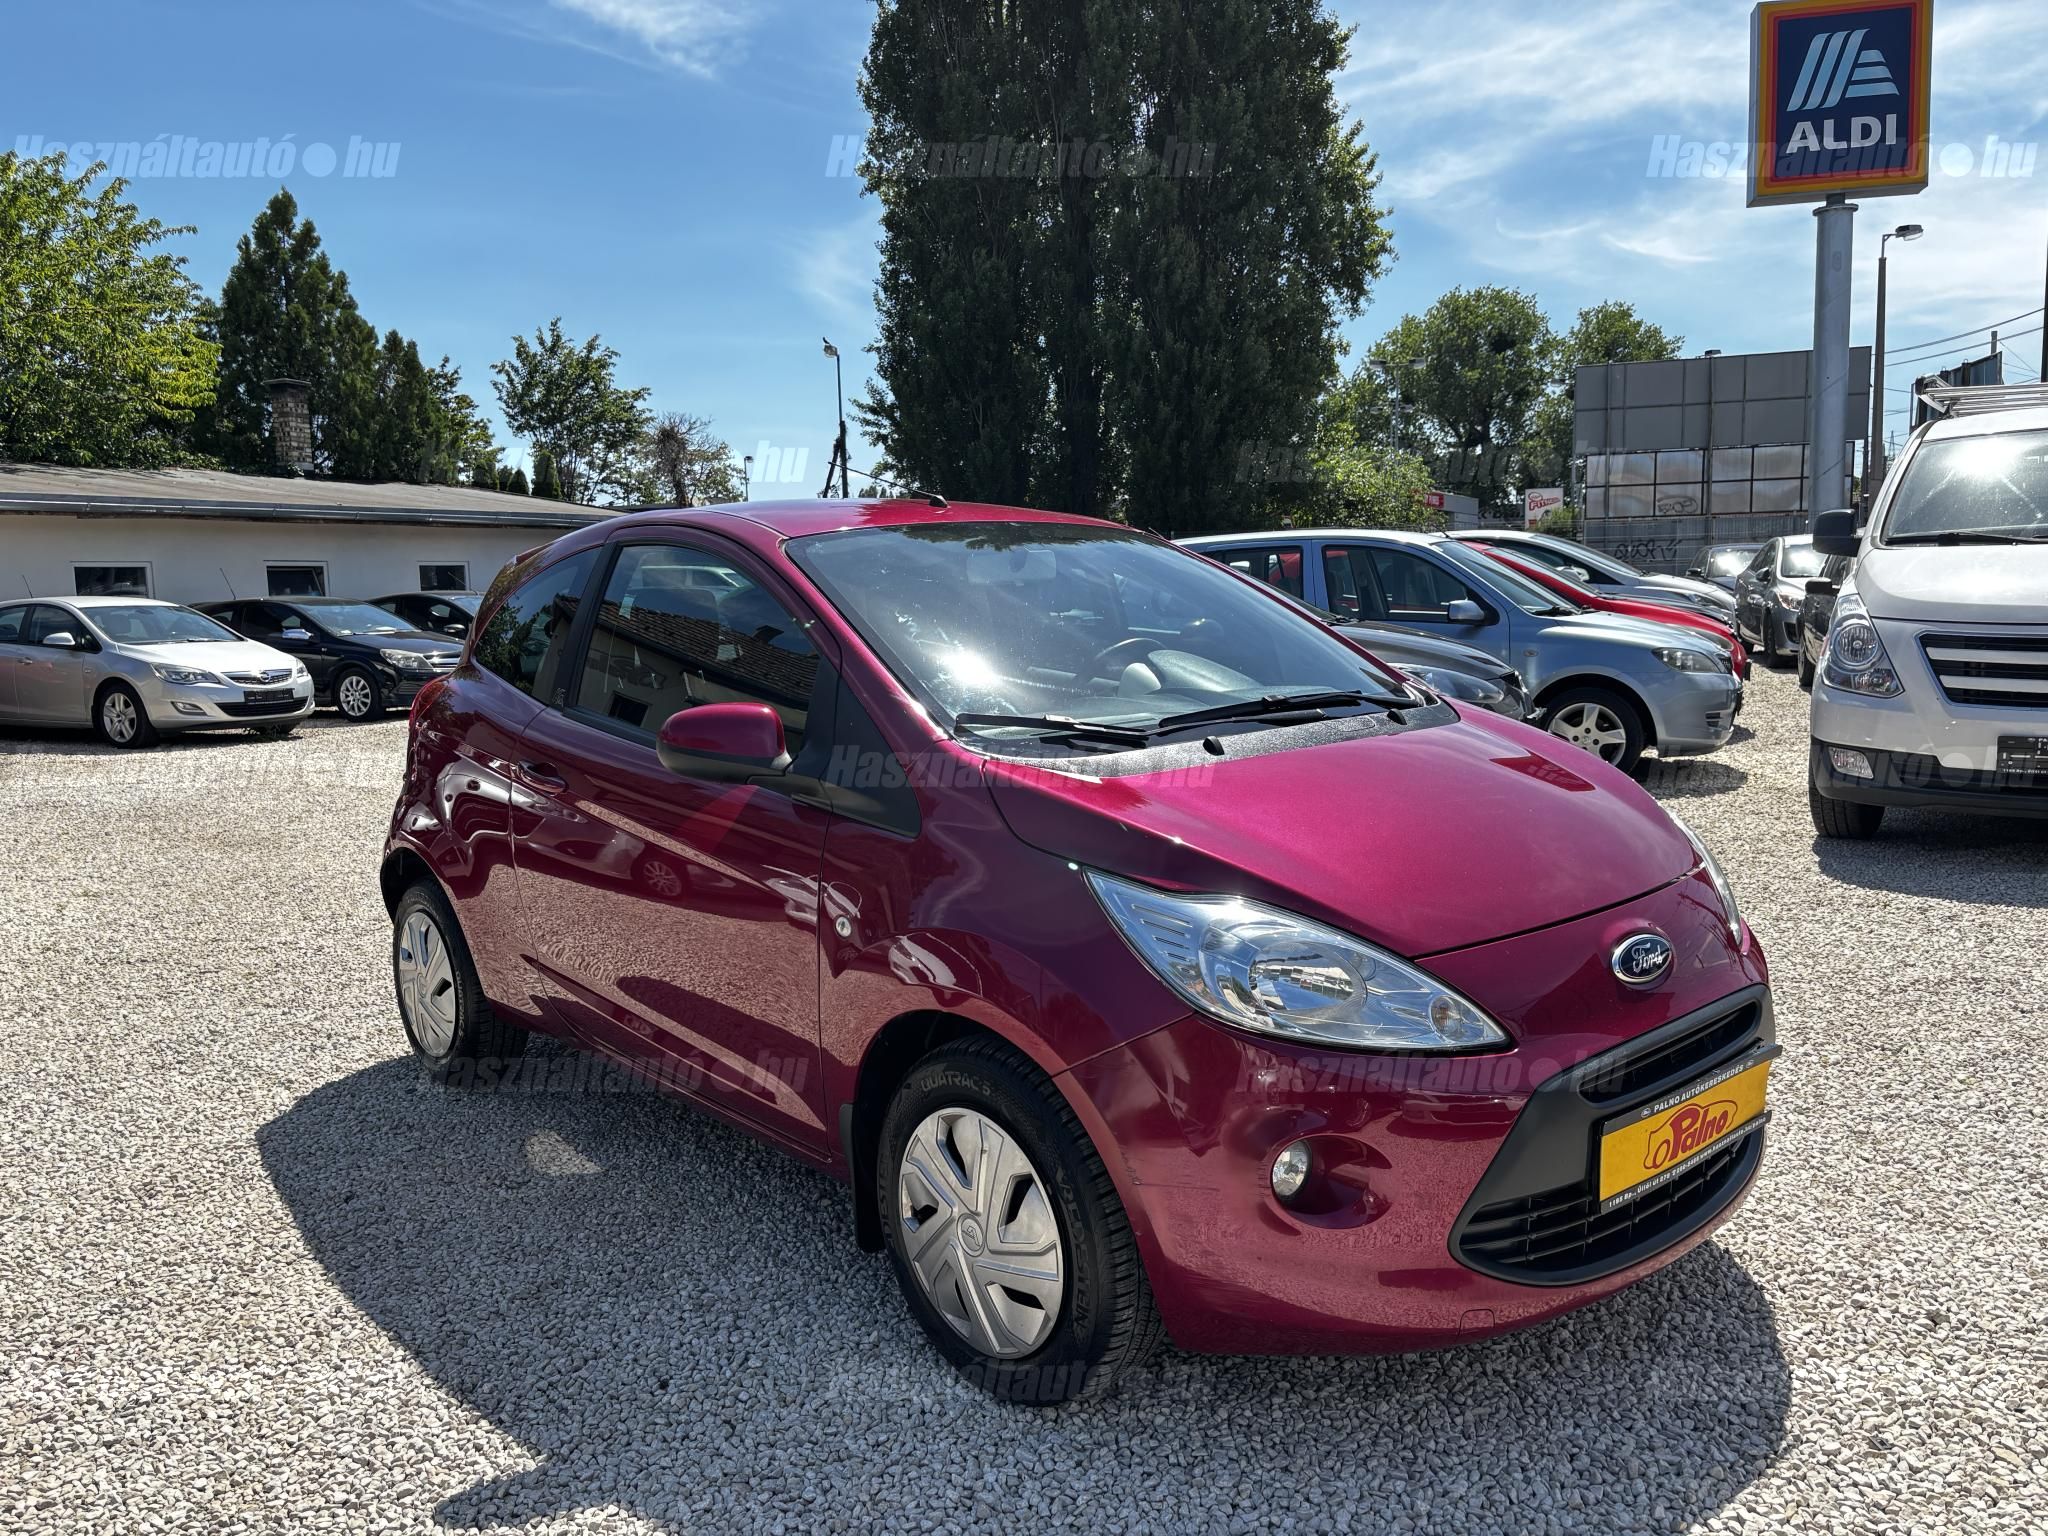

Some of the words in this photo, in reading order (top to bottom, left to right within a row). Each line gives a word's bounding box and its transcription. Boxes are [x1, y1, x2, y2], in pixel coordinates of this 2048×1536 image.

[1785, 113, 1897, 154] ALDI
[1631, 942, 1671, 974] Ford
[920, 1070, 981, 1092] QUATRAC
[1653, 1095, 1680, 1113] PALNO
[1680, 1063, 1744, 1102] AUTÓKERESKEDÉS
[1667, 1106, 1729, 1163] Palno
